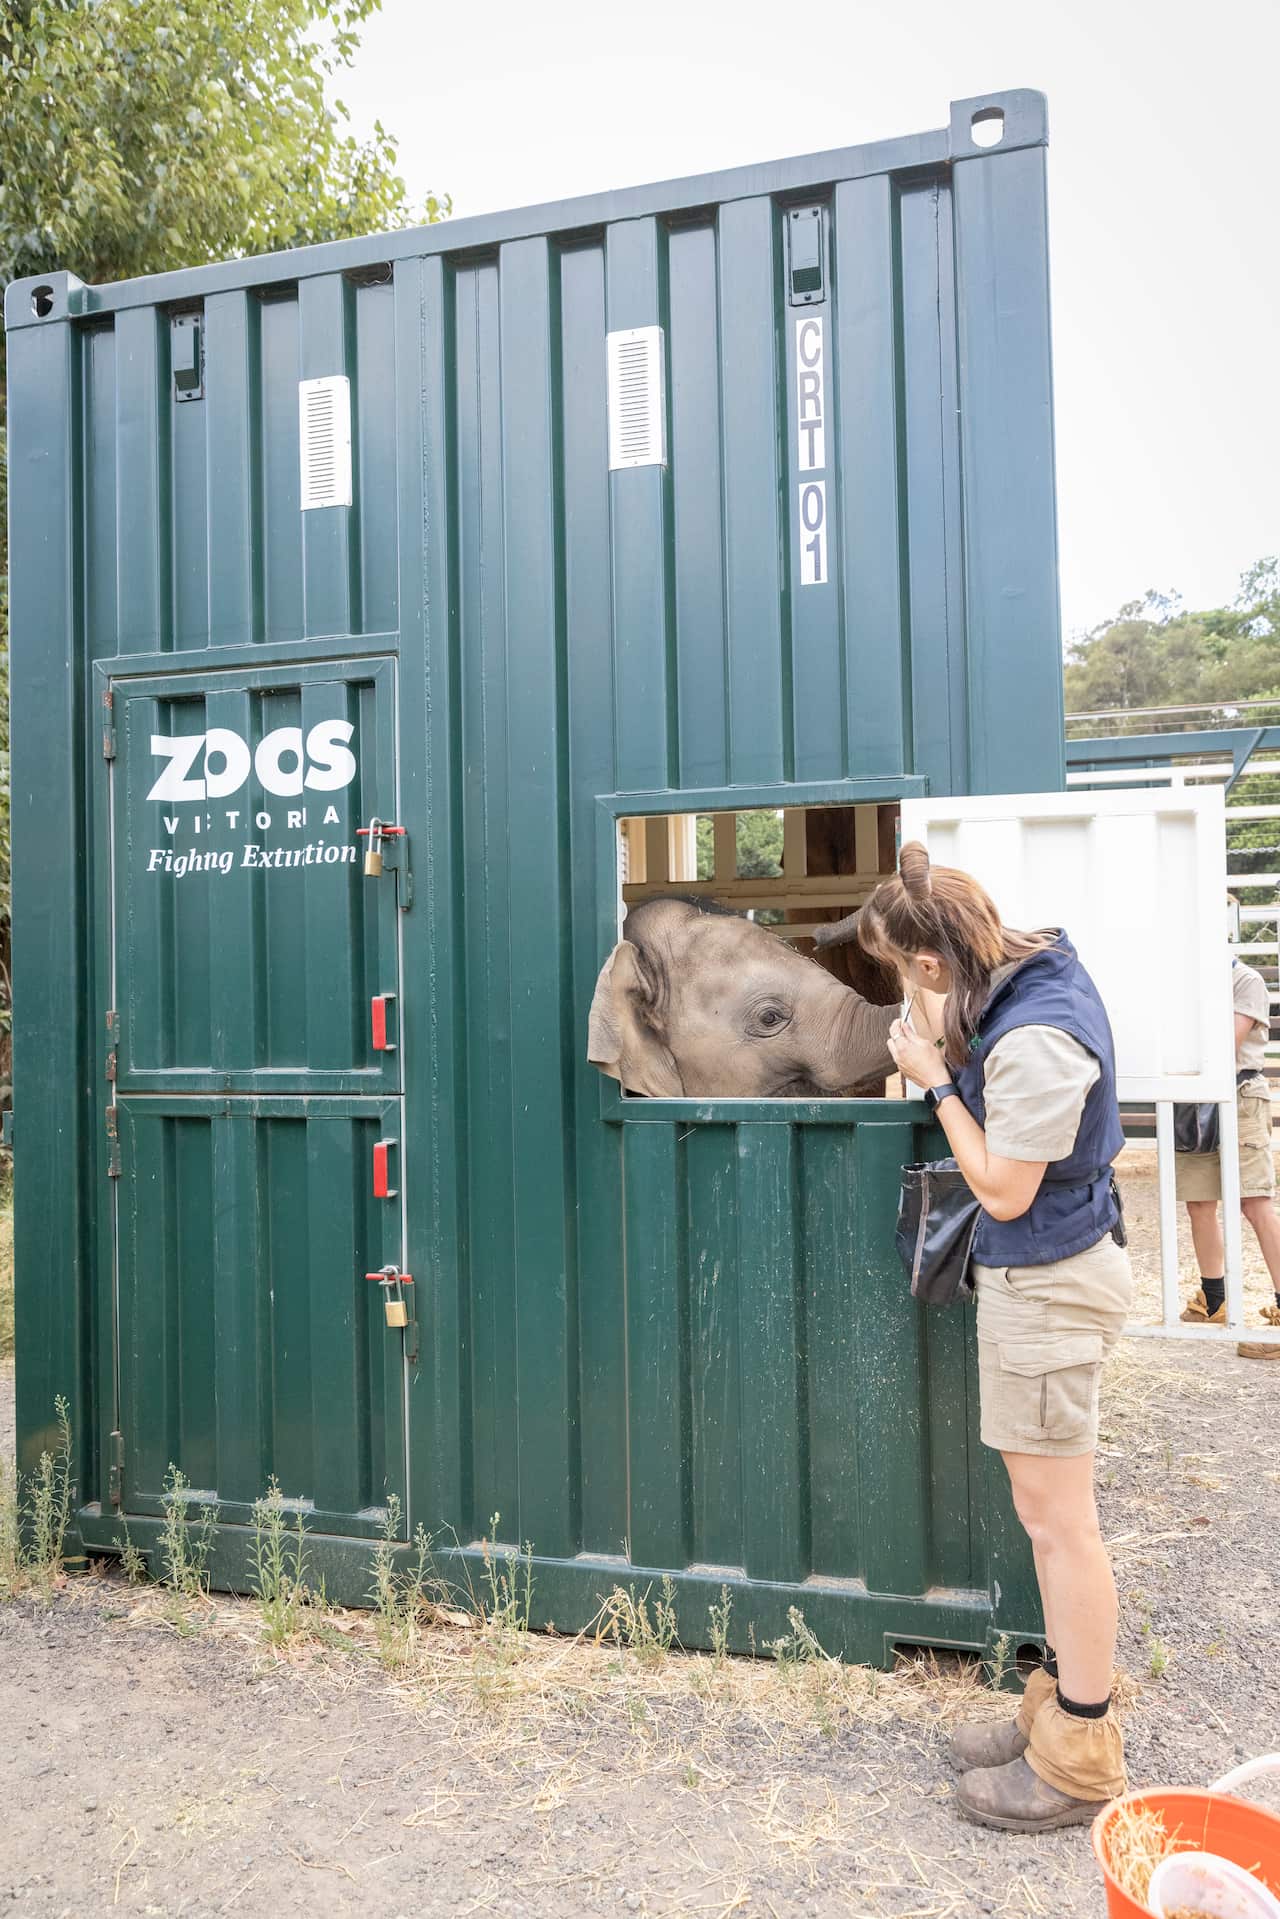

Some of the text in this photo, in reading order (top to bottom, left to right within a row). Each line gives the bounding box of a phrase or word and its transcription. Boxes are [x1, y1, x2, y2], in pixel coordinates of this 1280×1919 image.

[800, 321, 823, 581] CRT 01
[145, 719, 357, 802] ZOOS
[163, 805, 340, 834] VITORIA
[240, 839, 357, 868] Extintion
